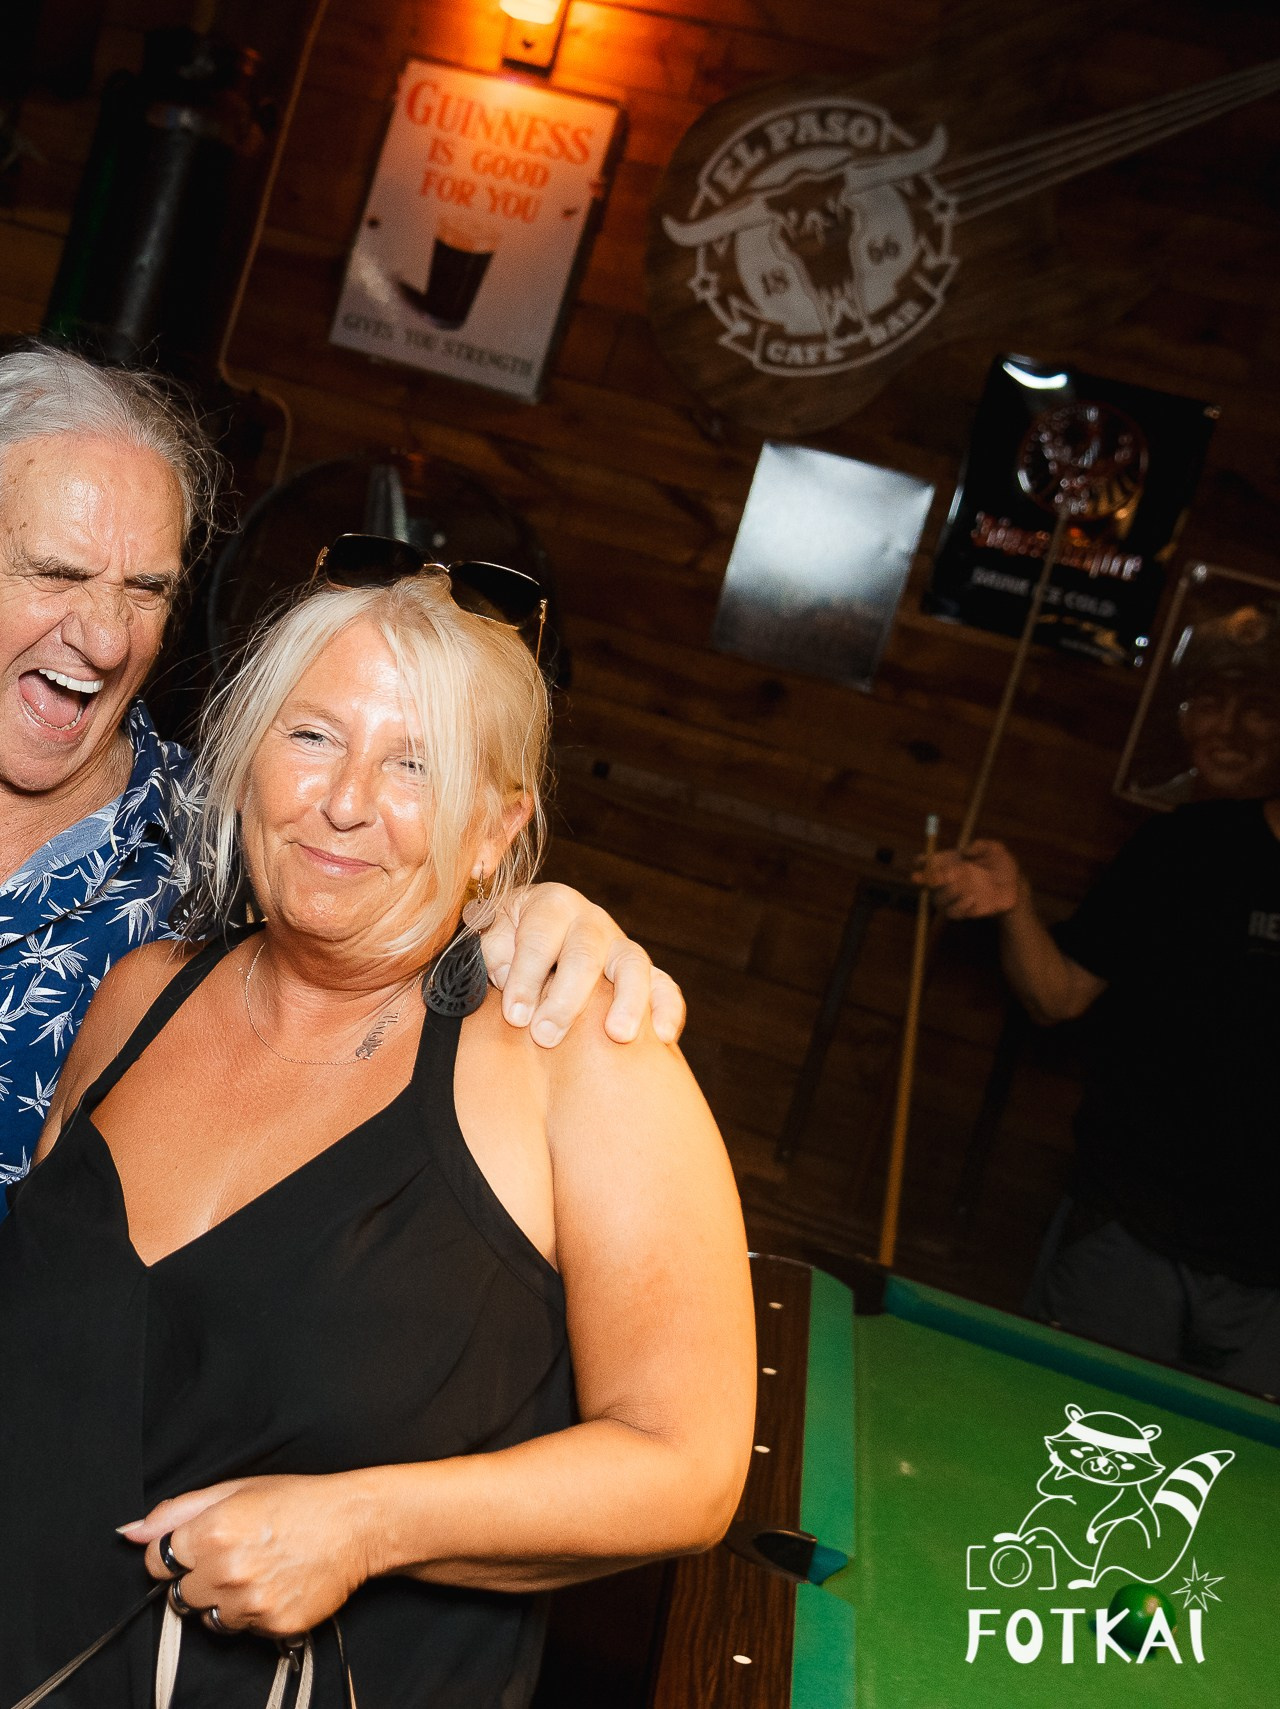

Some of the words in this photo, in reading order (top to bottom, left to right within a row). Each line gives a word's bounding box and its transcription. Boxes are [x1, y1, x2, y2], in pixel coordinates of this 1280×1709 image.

[406, 80, 593, 164] GUINNESS
[428, 137, 455, 166] IS
[471, 150, 550, 189] GOOD
[713, 143, 766, 194] EL
[765, 111, 877, 150] PASO
[420, 169, 476, 208] FOR
[486, 186, 544, 224] YOU
[868, 301, 921, 346] BAR
